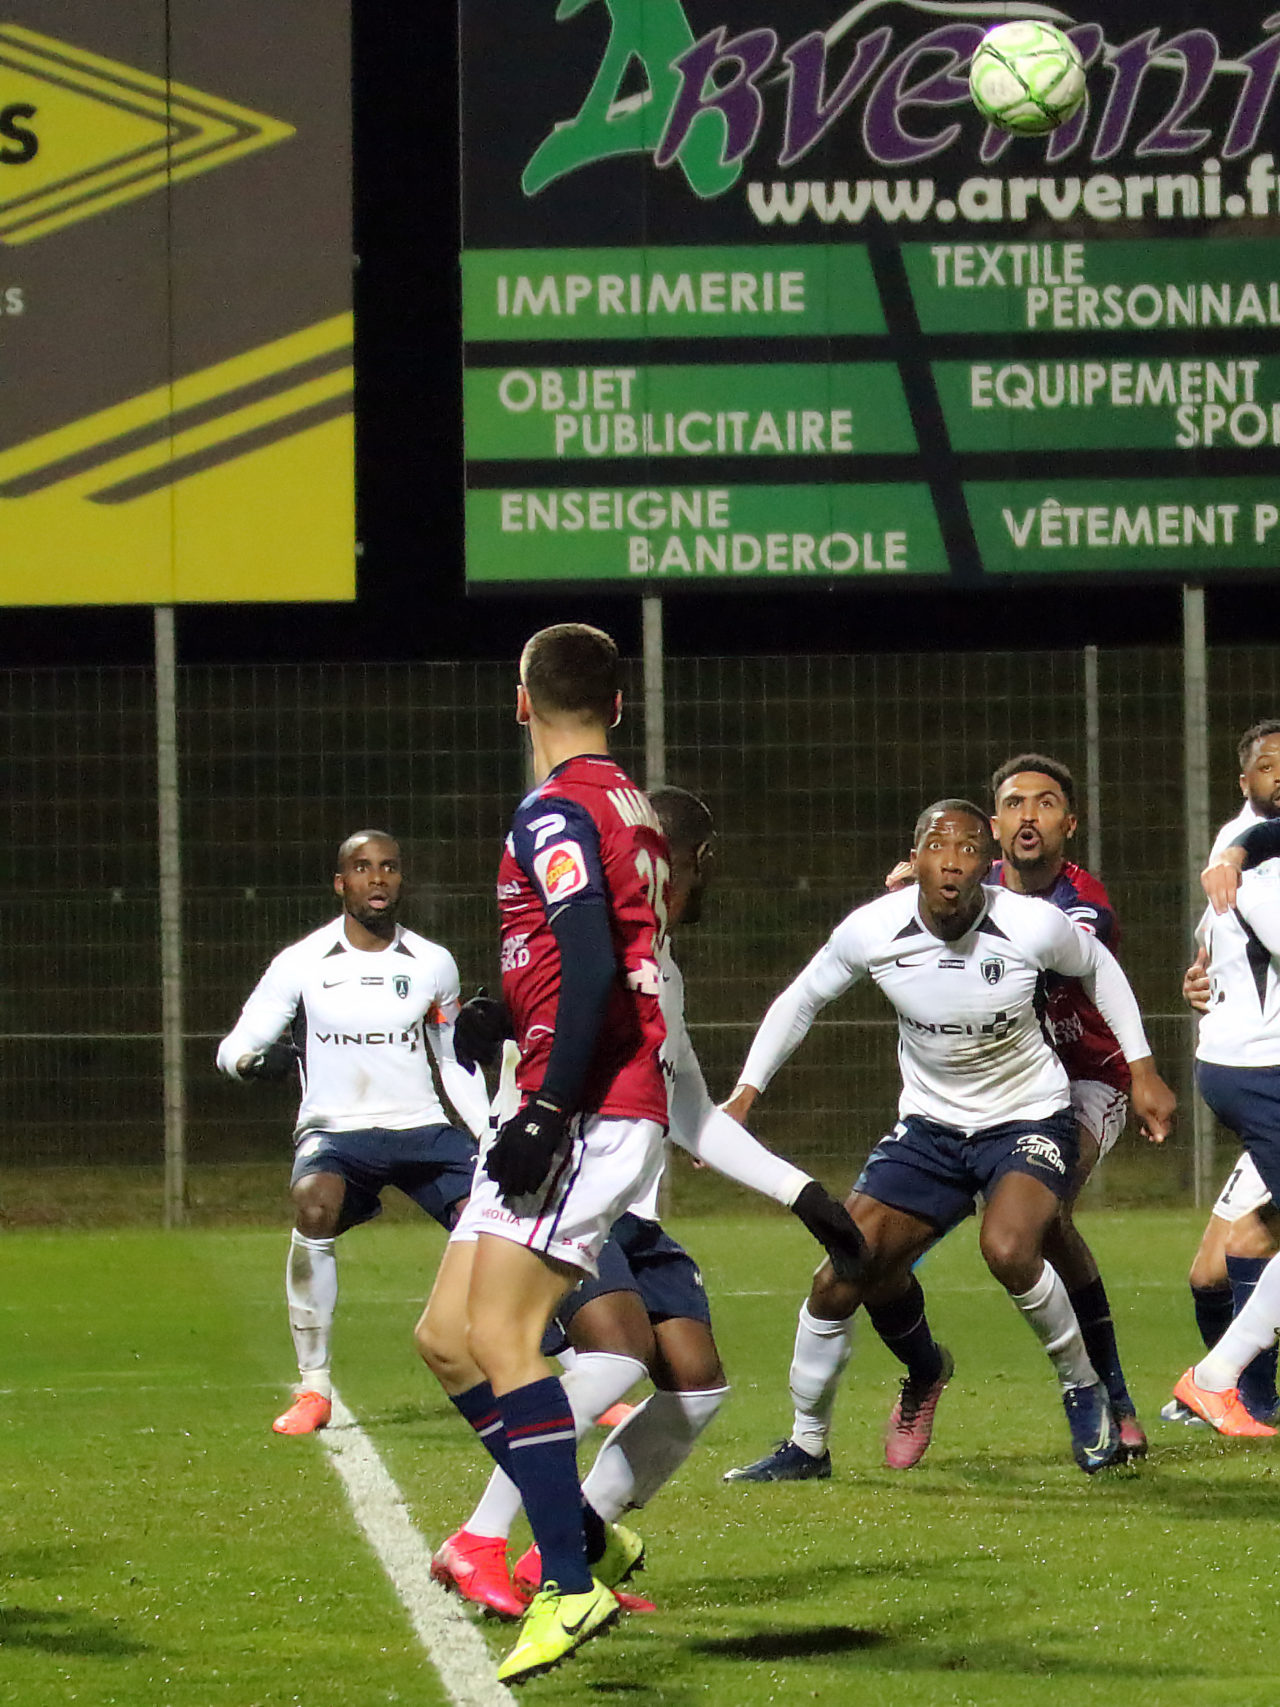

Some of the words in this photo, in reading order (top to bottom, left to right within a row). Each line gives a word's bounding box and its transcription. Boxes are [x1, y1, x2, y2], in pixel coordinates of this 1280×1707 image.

[931, 244, 1085, 287] TEXTILE
[497, 271, 806, 317] IMPRIMERIE
[499, 369, 636, 412] OBJET
[970, 361, 1260, 410] EQUIPEMENT
[554, 410, 853, 456] PUBLICITAIRE
[501, 490, 730, 532] ENSEIGNE
[1002, 498, 1240, 548] VÊTEMENT
[628, 531, 907, 574] BANDEROLE
[316, 1032, 393, 1045] VINCI
